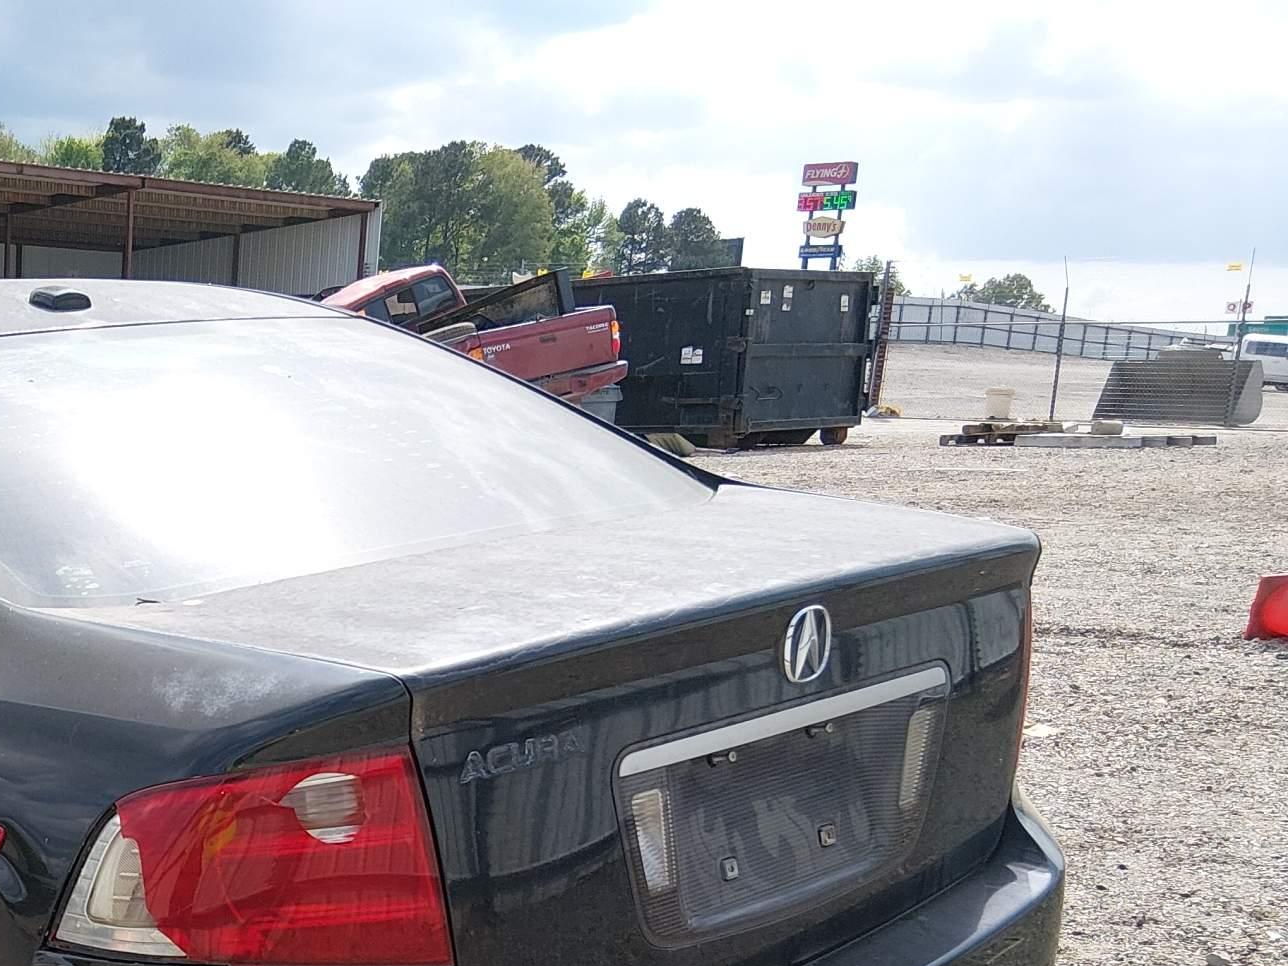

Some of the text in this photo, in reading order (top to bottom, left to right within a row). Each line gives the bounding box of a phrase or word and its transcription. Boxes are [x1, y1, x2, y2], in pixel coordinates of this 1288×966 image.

[805, 167, 838, 179] FLYING
[807, 221, 837, 233] Denny's
[483, 343, 511, 355] TOYOTA
[459, 732, 585, 784] ACURA
